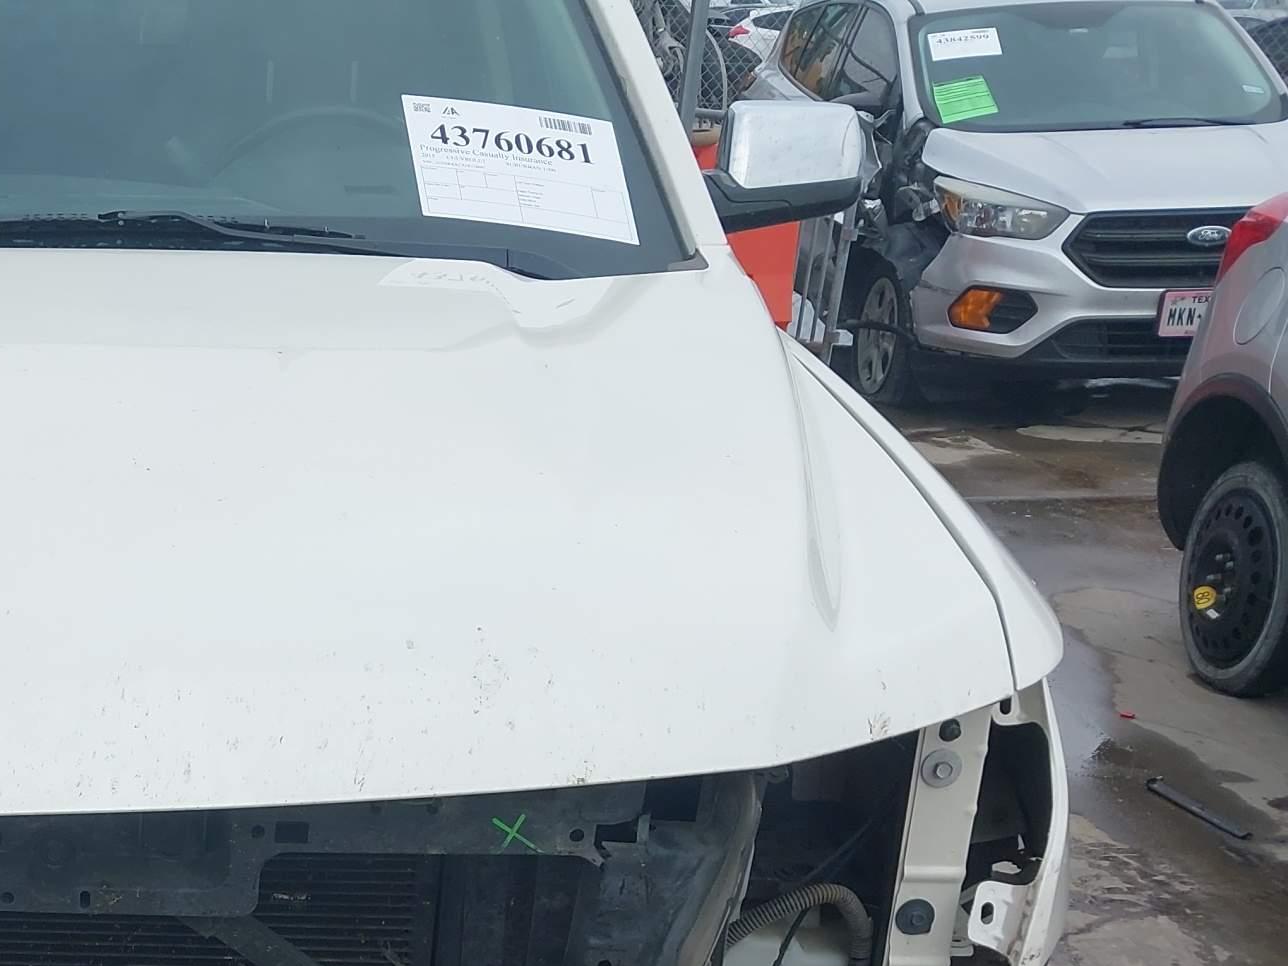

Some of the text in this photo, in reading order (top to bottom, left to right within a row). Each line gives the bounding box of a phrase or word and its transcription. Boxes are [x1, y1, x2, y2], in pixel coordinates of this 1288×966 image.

[419, 144, 471, 154] Progressive
[512, 154, 553, 165] Insurance
[430, 123, 595, 165] 43760681
